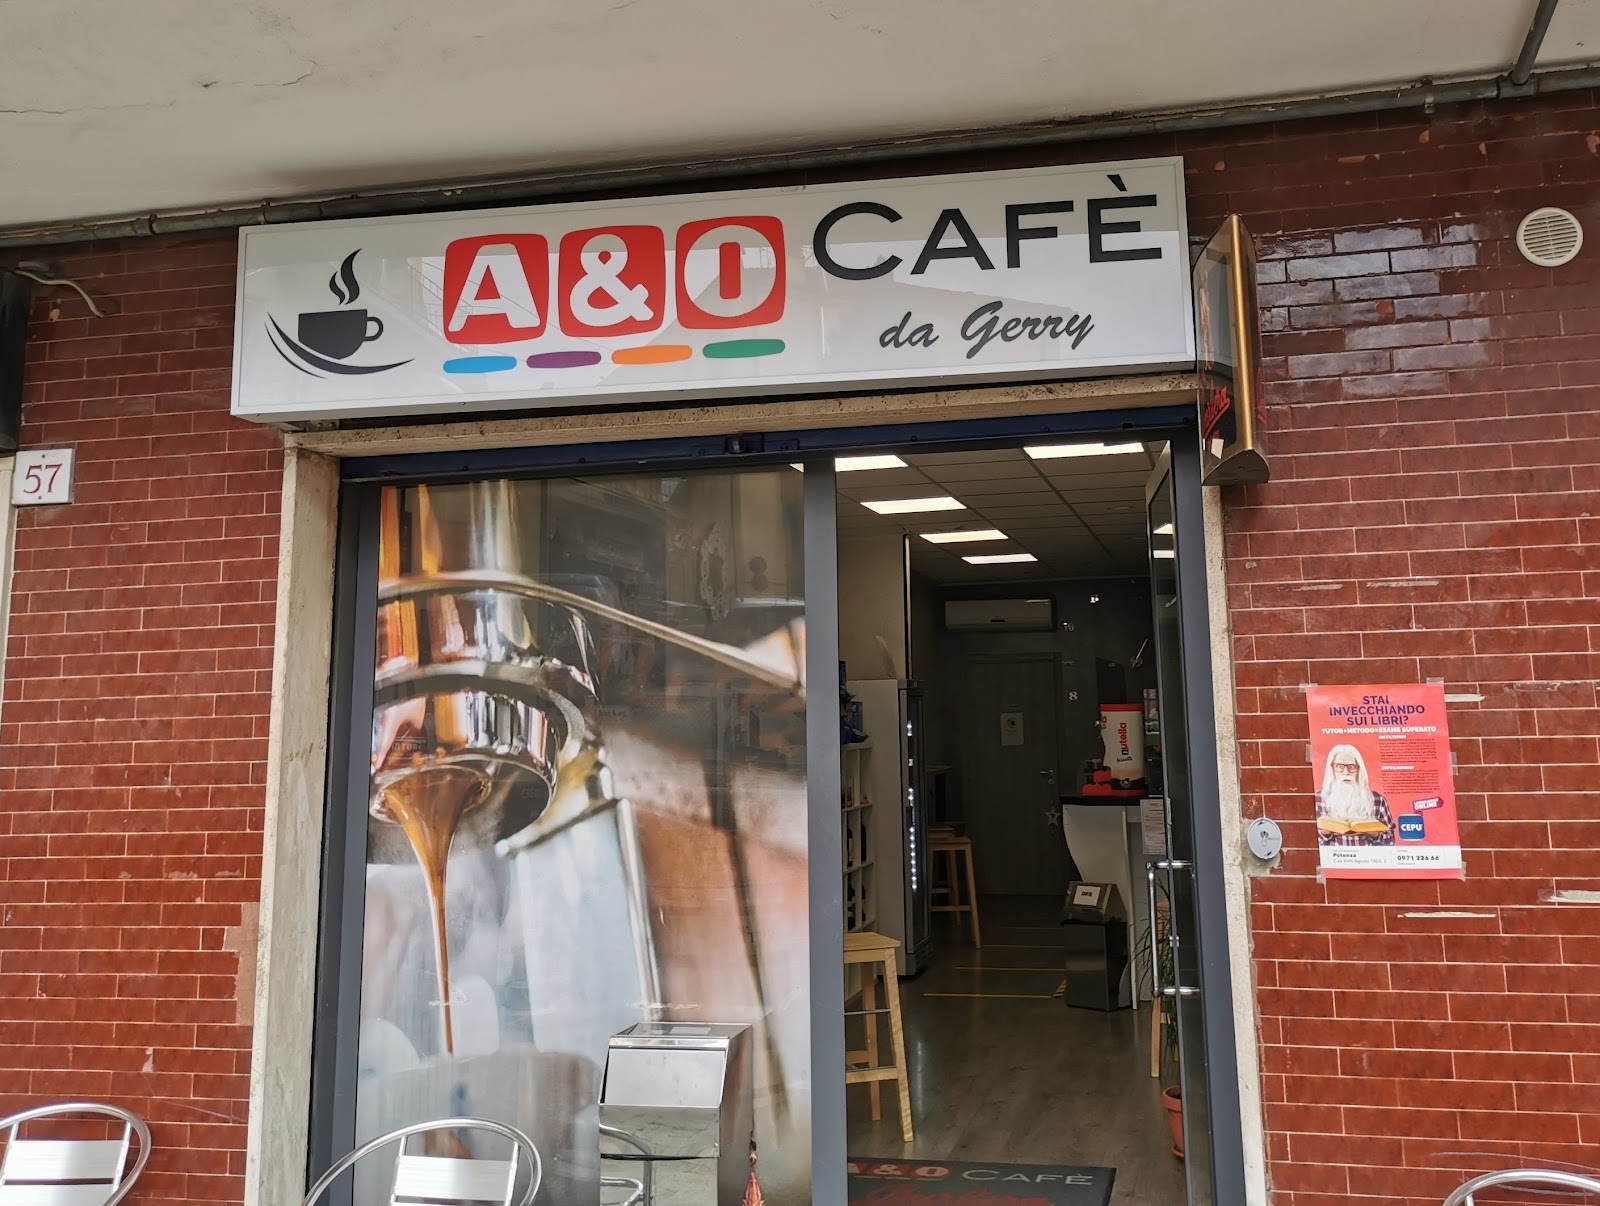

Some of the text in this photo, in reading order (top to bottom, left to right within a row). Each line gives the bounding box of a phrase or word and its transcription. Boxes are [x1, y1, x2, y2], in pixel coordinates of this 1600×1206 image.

[446, 174, 1163, 333] A&O CAFÈ
[879, 300, 1095, 359] da Gerry
[23, 463, 63, 494] 57
[1362, 695, 1389, 705] STAI
[1329, 705, 1425, 716] INVECCHIANDO
[1346, 715, 1409, 726] SUI LIBRI?
[1117, 722, 1129, 755] nutella
[1400, 823, 1423, 832] CEPU
[961, 1168, 1093, 1186] CAFÈ
